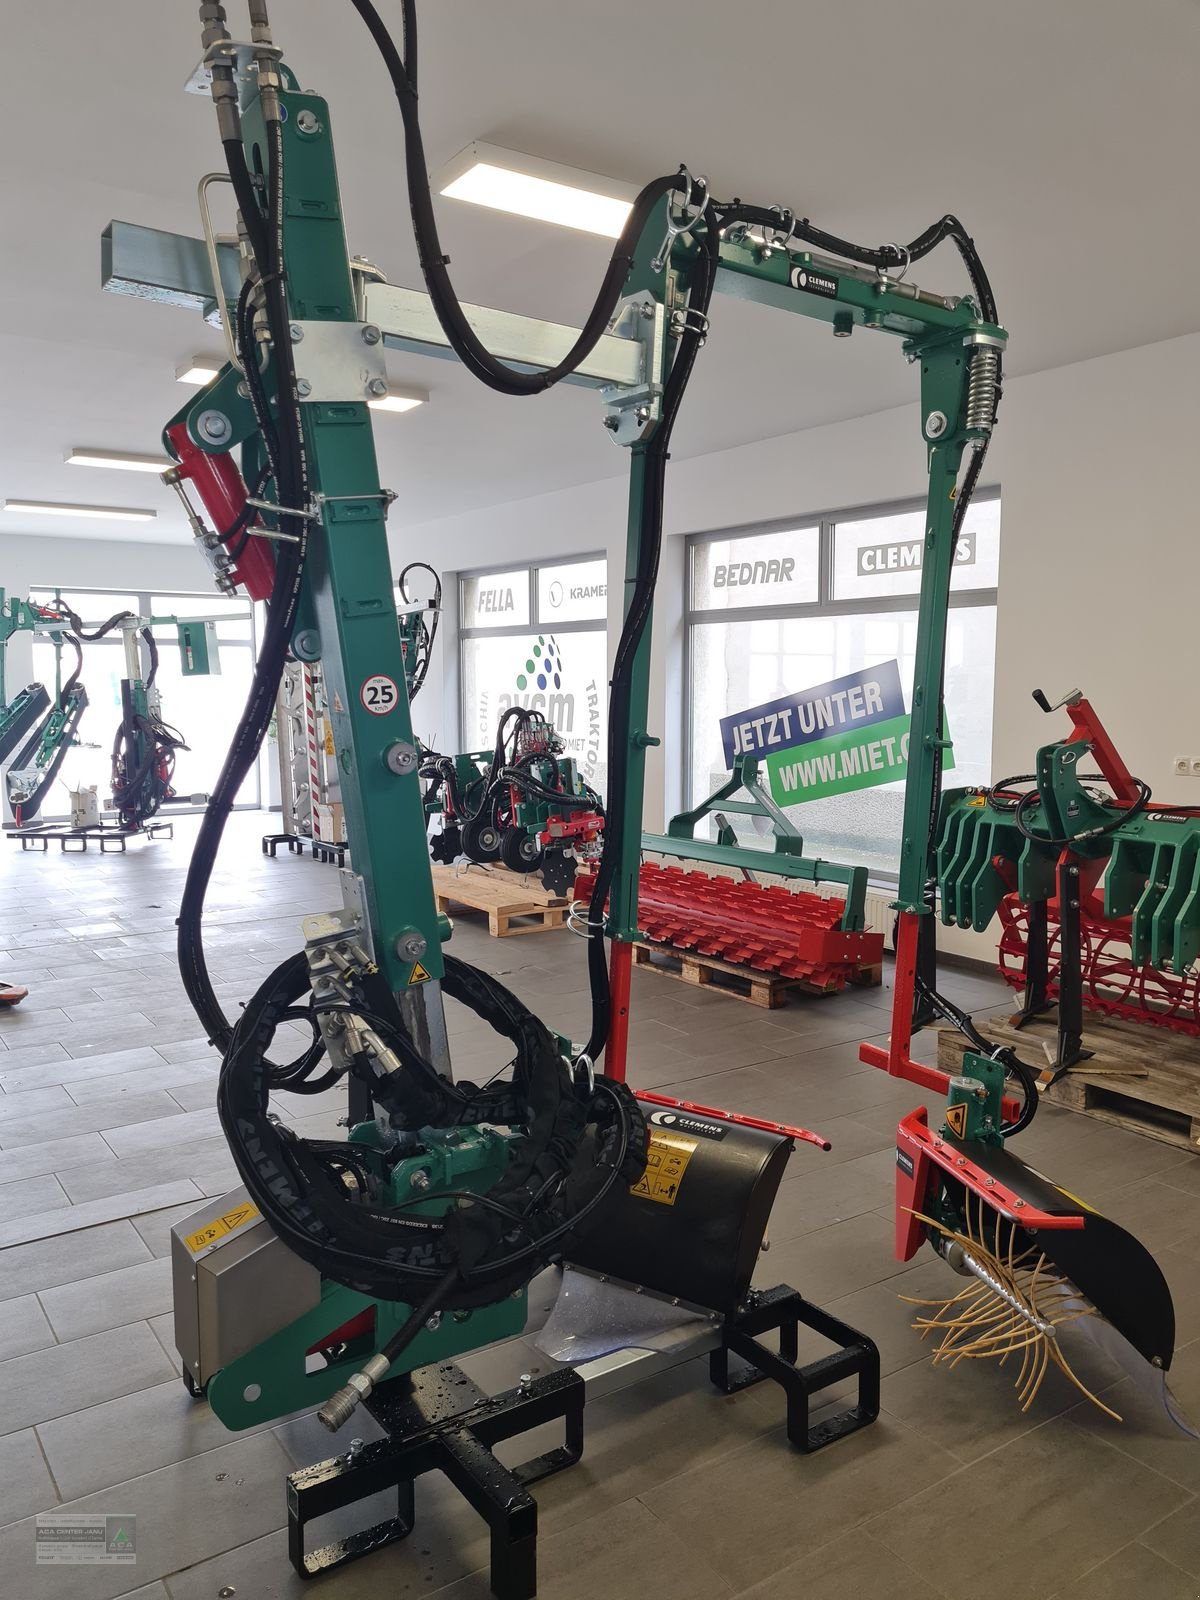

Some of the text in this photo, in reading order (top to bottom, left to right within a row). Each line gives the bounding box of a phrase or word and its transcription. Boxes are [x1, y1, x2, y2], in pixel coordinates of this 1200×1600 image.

[808, 276, 836, 290] CLEMENS
[861, 539, 971, 572] CLEMS
[713, 557, 796, 588] BEDNAR
[478, 588, 514, 613] FELLA
[366, 685, 394, 705] 25
[732, 681, 884, 756] JETZT UNTER
[679, 1118, 723, 1133] CLEMENS
